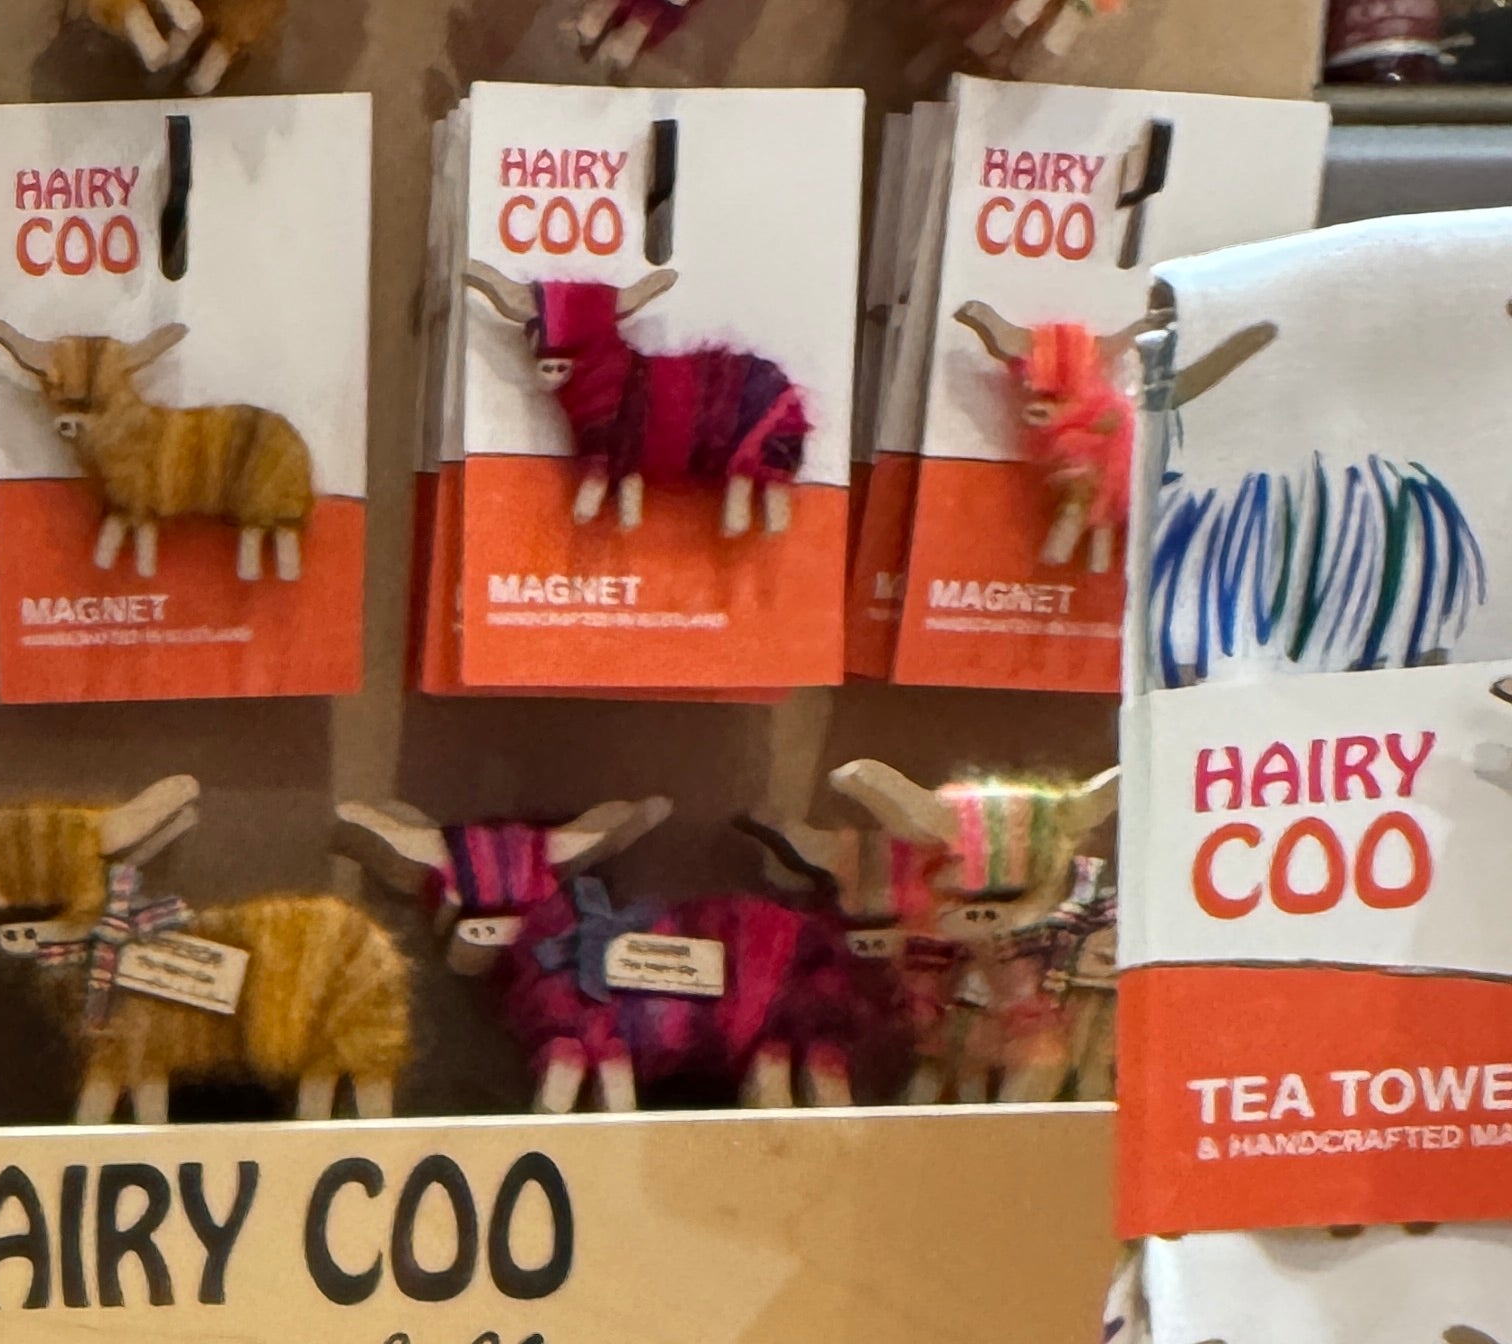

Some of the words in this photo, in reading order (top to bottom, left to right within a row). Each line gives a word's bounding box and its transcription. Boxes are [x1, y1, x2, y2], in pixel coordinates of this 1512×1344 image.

[15, 167, 139, 209] HAIRY
[499, 148, 628, 189] HAIRY
[981, 147, 1104, 193] HAIRY
[16, 216, 139, 276] COO
[498, 195, 624, 255] COO
[975, 197, 1096, 260] COO
[21, 594, 169, 624] MAGNET
[488, 574, 641, 604] MAGNET
[929, 580, 1076, 613] MAGNET
[1194, 731, 1435, 812] HAIRY
[1192, 811, 1432, 919] COO
[1188, 1073, 1315, 1124] TEA
[1329, 1063, 1512, 1117] TOWE
[1229, 1124, 1463, 1158] HANDCRAFTED
[305, 1151, 574, 1305] COO
